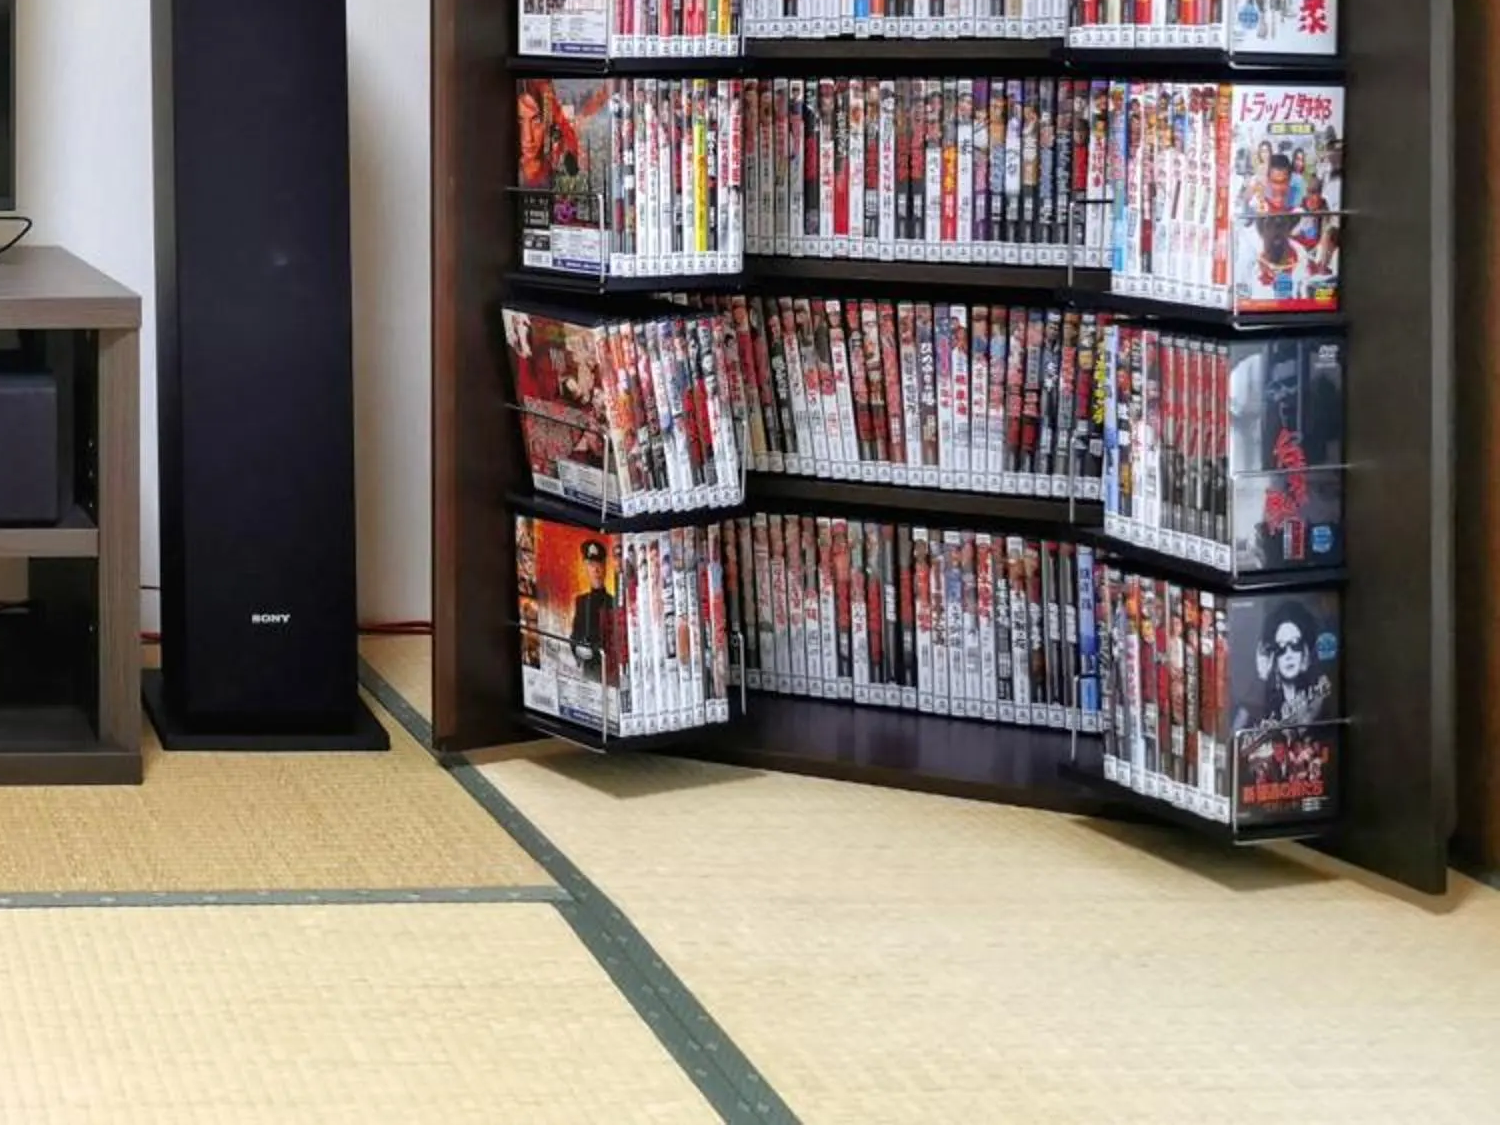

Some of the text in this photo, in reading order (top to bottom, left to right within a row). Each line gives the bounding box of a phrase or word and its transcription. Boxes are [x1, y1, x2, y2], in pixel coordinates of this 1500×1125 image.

[1239, 91, 1333, 125] トラック野郎
[251, 614, 292, 624] SONY
